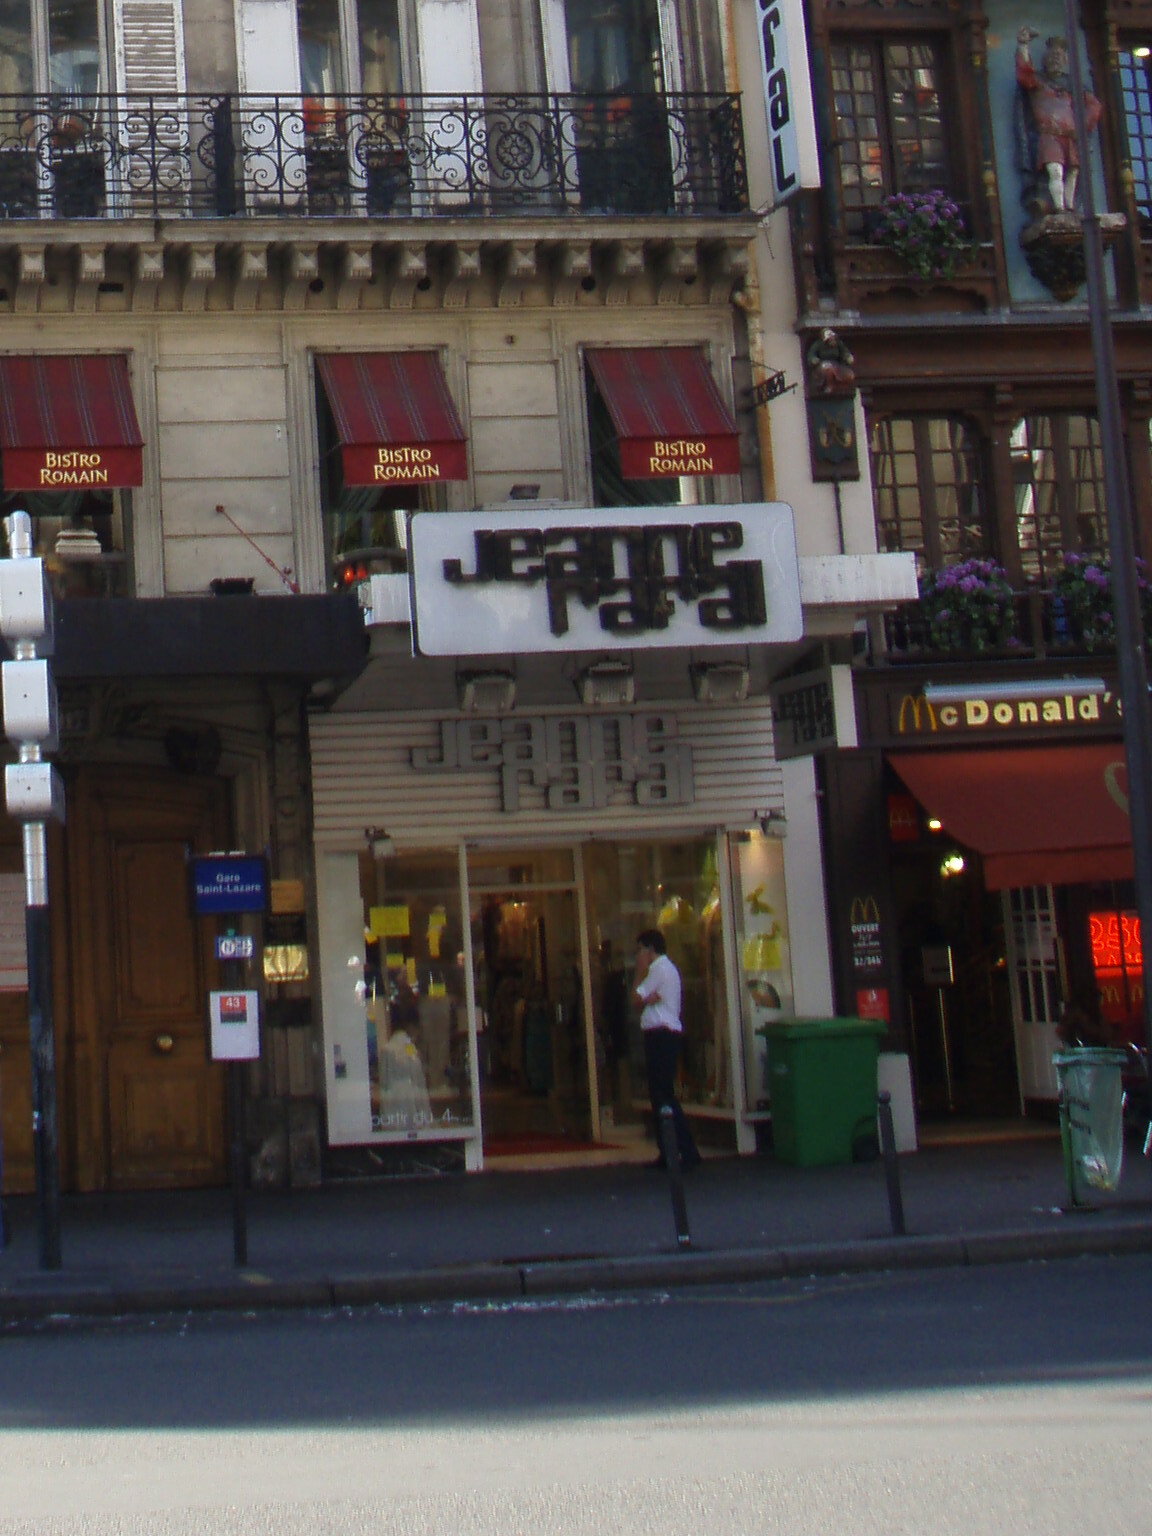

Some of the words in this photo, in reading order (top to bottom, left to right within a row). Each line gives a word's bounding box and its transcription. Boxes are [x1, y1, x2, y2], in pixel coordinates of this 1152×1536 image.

[378, 448, 432, 464] BISTRO
[654, 441, 706, 457] BISTRO
[45, 452, 101, 468] BISTRO
[649, 456, 714, 473] ROMAIN
[40, 468, 108, 485] ROMAIN
[374, 464, 440, 481] ROMAIN
[216, 873, 241, 883] Gare
[196, 883, 262, 895] Saint-Lazare
[225, 997, 240, 1008] 43
